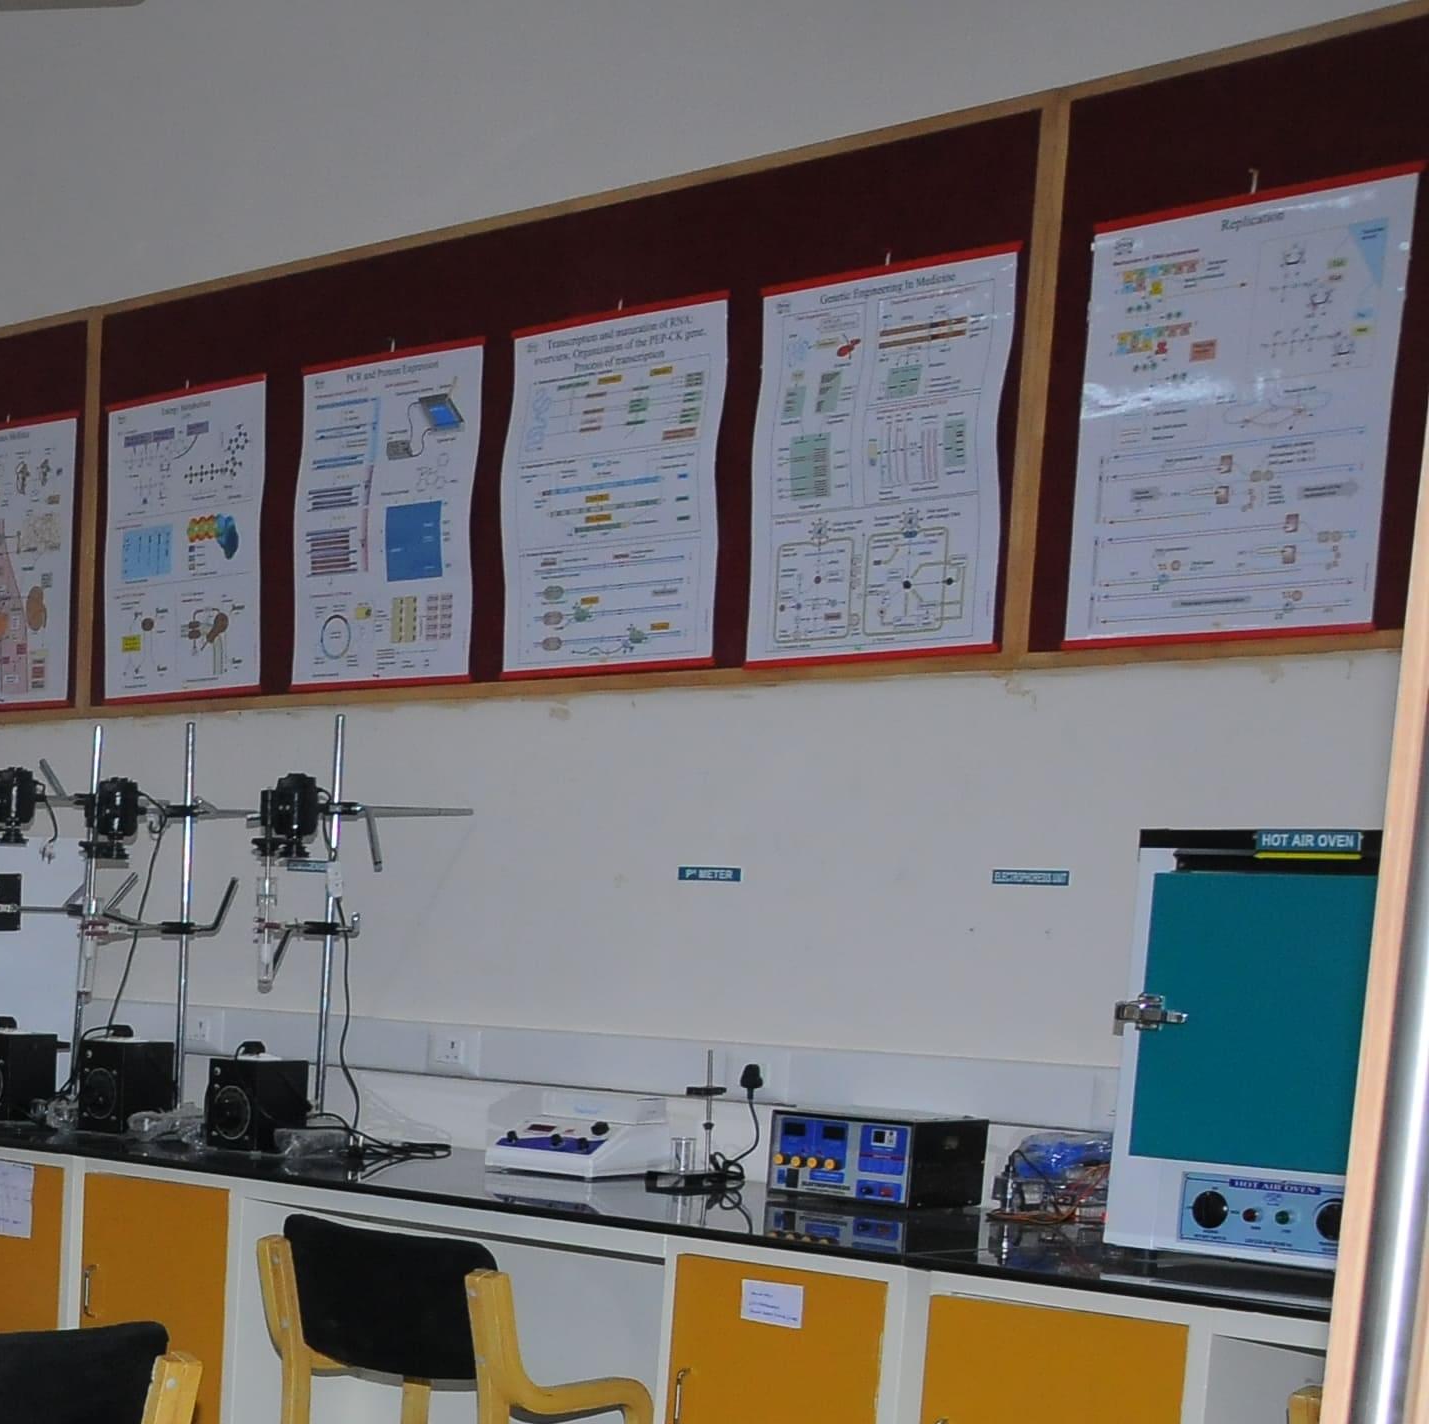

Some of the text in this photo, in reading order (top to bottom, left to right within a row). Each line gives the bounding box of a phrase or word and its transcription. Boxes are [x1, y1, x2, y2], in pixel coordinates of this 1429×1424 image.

[820, 288, 852, 305] Genetic
[853, 281, 904, 300] Engineering
[916, 272, 957, 289] Medicine
[548, 333, 598, 350] Transcription
[599, 329, 614, 341] and
[659, 318, 669, 329] of
[624, 339, 635, 351] of
[635, 336, 648, 348] the
[605, 357, 615, 369] of
[1262, 834, 1354, 848] HOT AIR OVEN
[698, 869, 734, 879] METER
[1233, 1180, 1317, 1194] HOT AIR OVEN
